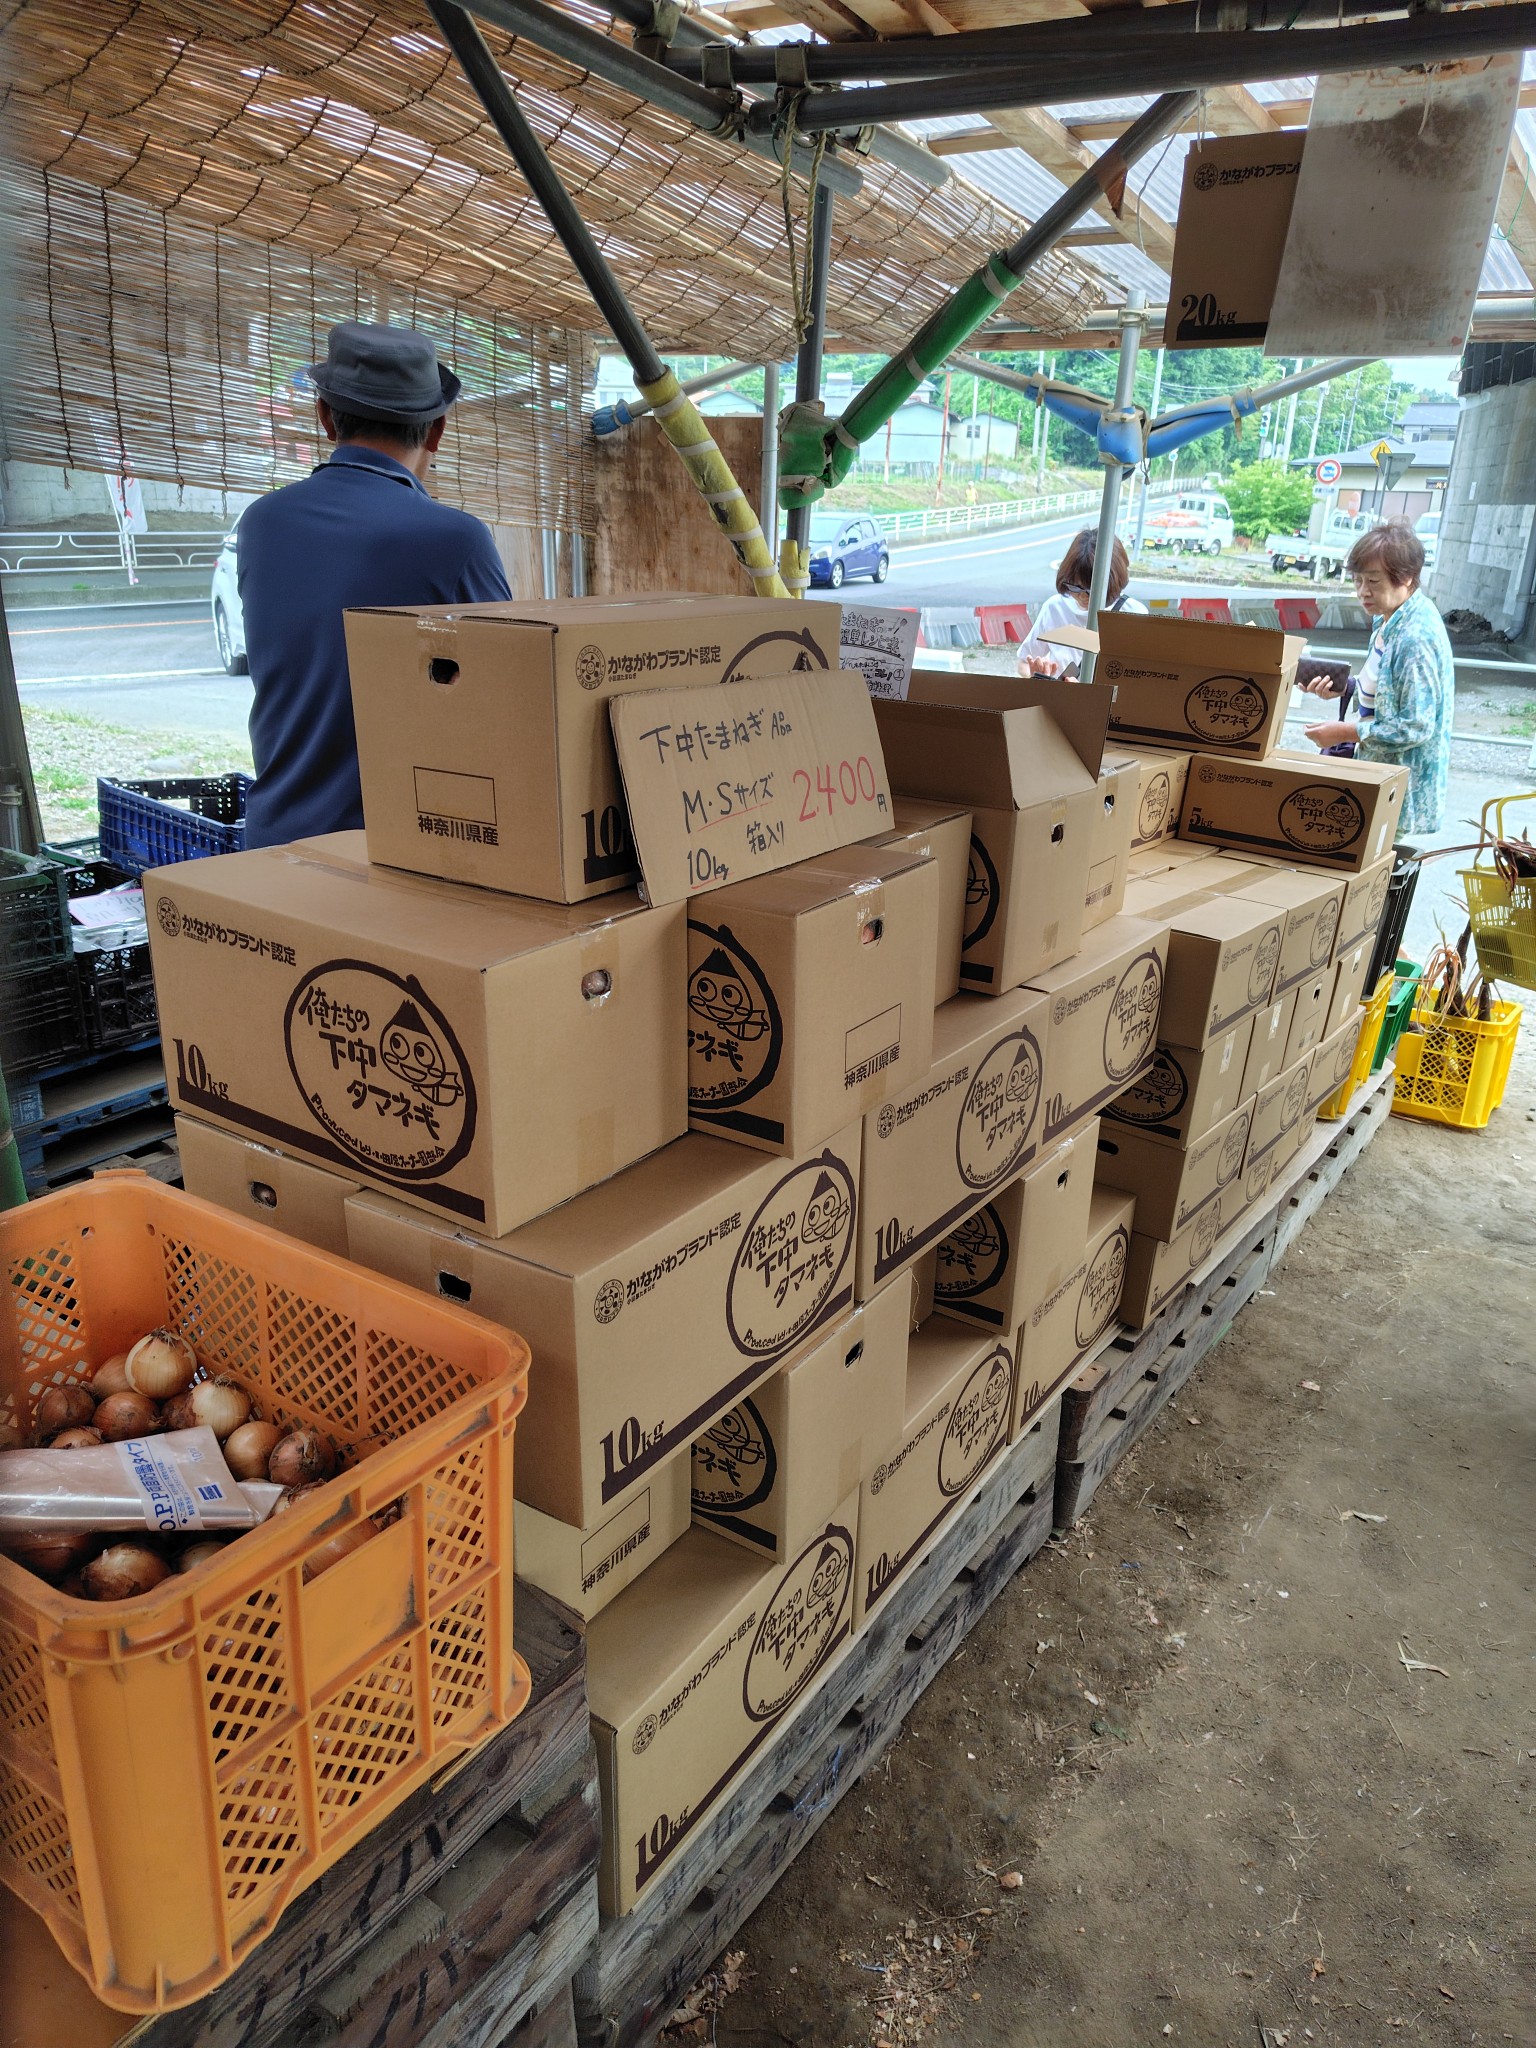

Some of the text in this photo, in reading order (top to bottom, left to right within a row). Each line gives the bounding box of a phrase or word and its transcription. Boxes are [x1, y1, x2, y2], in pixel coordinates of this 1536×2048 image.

[1181, 293, 1237, 326] 20kg
[607, 645, 721, 675] かながわブランド認定
[1195, 685, 1228, 699] 俺たちの
[1202, 699, 1227, 713] 下中
[639, 708, 765, 764] 下中たまねぎ
[1210, 713, 1250, 728] タマネギ
[1190, 807, 1213, 828] 5kg
[1289, 793, 1324, 807] 俺たちの
[1297, 807, 1323, 820] 下中
[418, 815, 499, 847] 神奈川県産
[687, 820, 784, 885] 10kg 箱入り
[1304, 822, 1345, 838] タマネギ
[182, 914, 296, 967] かながわブランド認定
[299, 985, 370, 1033] 俺たちの
[1118, 1003, 1137, 1033] 下中
[1123, 1015, 1151, 1050] タマネギ
[172, 1038, 229, 1101] 10kg
[318, 1030, 376, 1078] 下中
[844, 1045, 900, 1090] 神奈川県産
[347, 1079, 440, 1140] タマネギ
[896, 1066, 969, 1121] かながわブランド認定
[966, 1072, 1003, 1114] 俺たちの
[976, 1093, 1004, 1132] 下中
[1042, 1092, 1071, 1130] 10kg
[311, 1092, 358, 1147] Produced
[986, 1105, 1026, 1151] タマネギ
[627, 1211, 742, 1298] かながわブランド認定
[741, 1211, 796, 1269] 俺たちの
[757, 1236, 800, 1288] 下中
[874, 1217, 915, 1264] 10kg
[937, 1244, 977, 1276] ネギ
[774, 1244, 834, 1308] タマネギ
[948, 1391, 980, 1439] 俺たちの
[956, 1408, 980, 1448] 下中
[964, 1407, 999, 1460] タマネギ
[600, 1416, 665, 1481] 10kg
[581, 1522, 651, 1595] 神奈川県産
[867, 1551, 900, 1599] 10kg
[755, 1587, 802, 1655] 俺たちの
[768, 1606, 804, 1660] 下中
[783, 1597, 835, 1672] タマネギ
[659, 1611, 756, 1725] かながわブランド認定
[635, 1805, 690, 1878] 10kg
